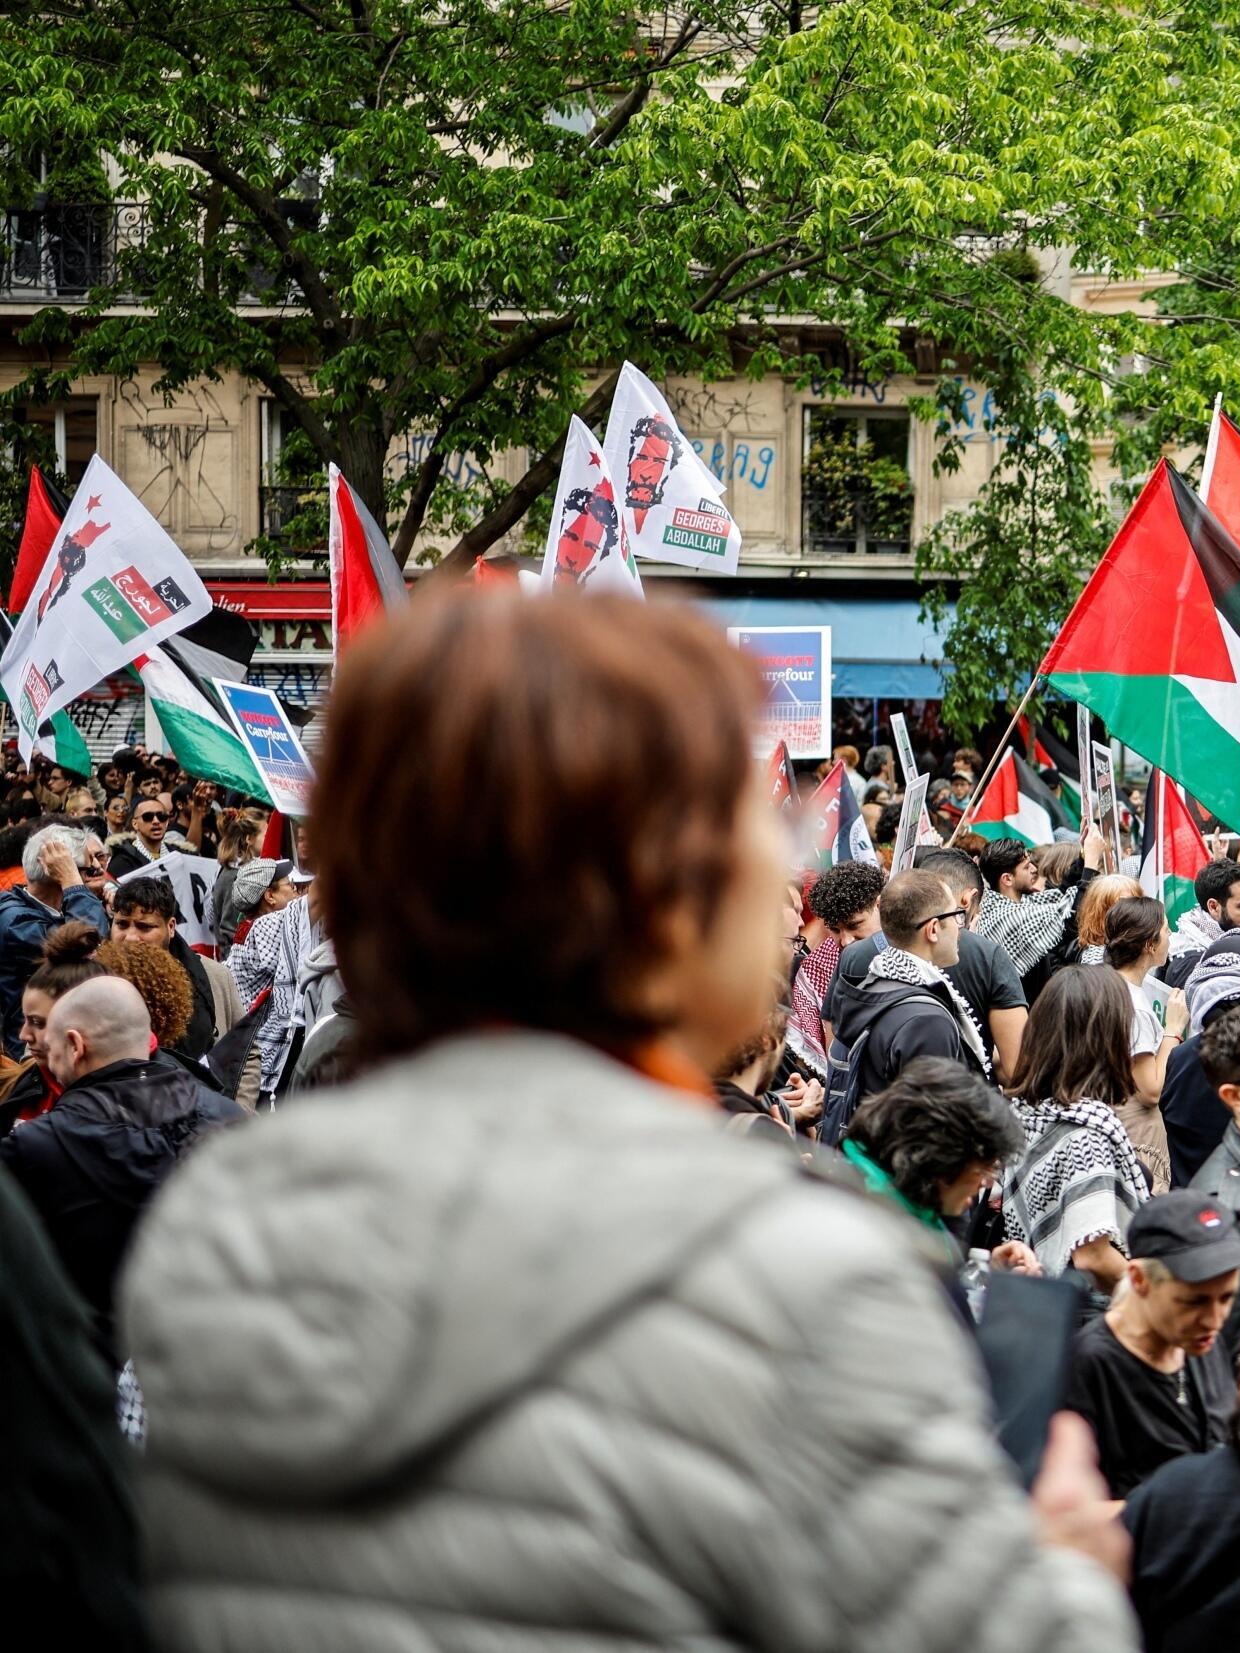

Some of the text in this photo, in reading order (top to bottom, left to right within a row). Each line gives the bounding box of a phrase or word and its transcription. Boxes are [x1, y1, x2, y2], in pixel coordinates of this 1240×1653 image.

[675, 511, 725, 534] GEORGES
[666, 529, 721, 553] ABDALLAH
[116, 574, 161, 615] لجورج
[760, 667, 815, 681] arrefour
